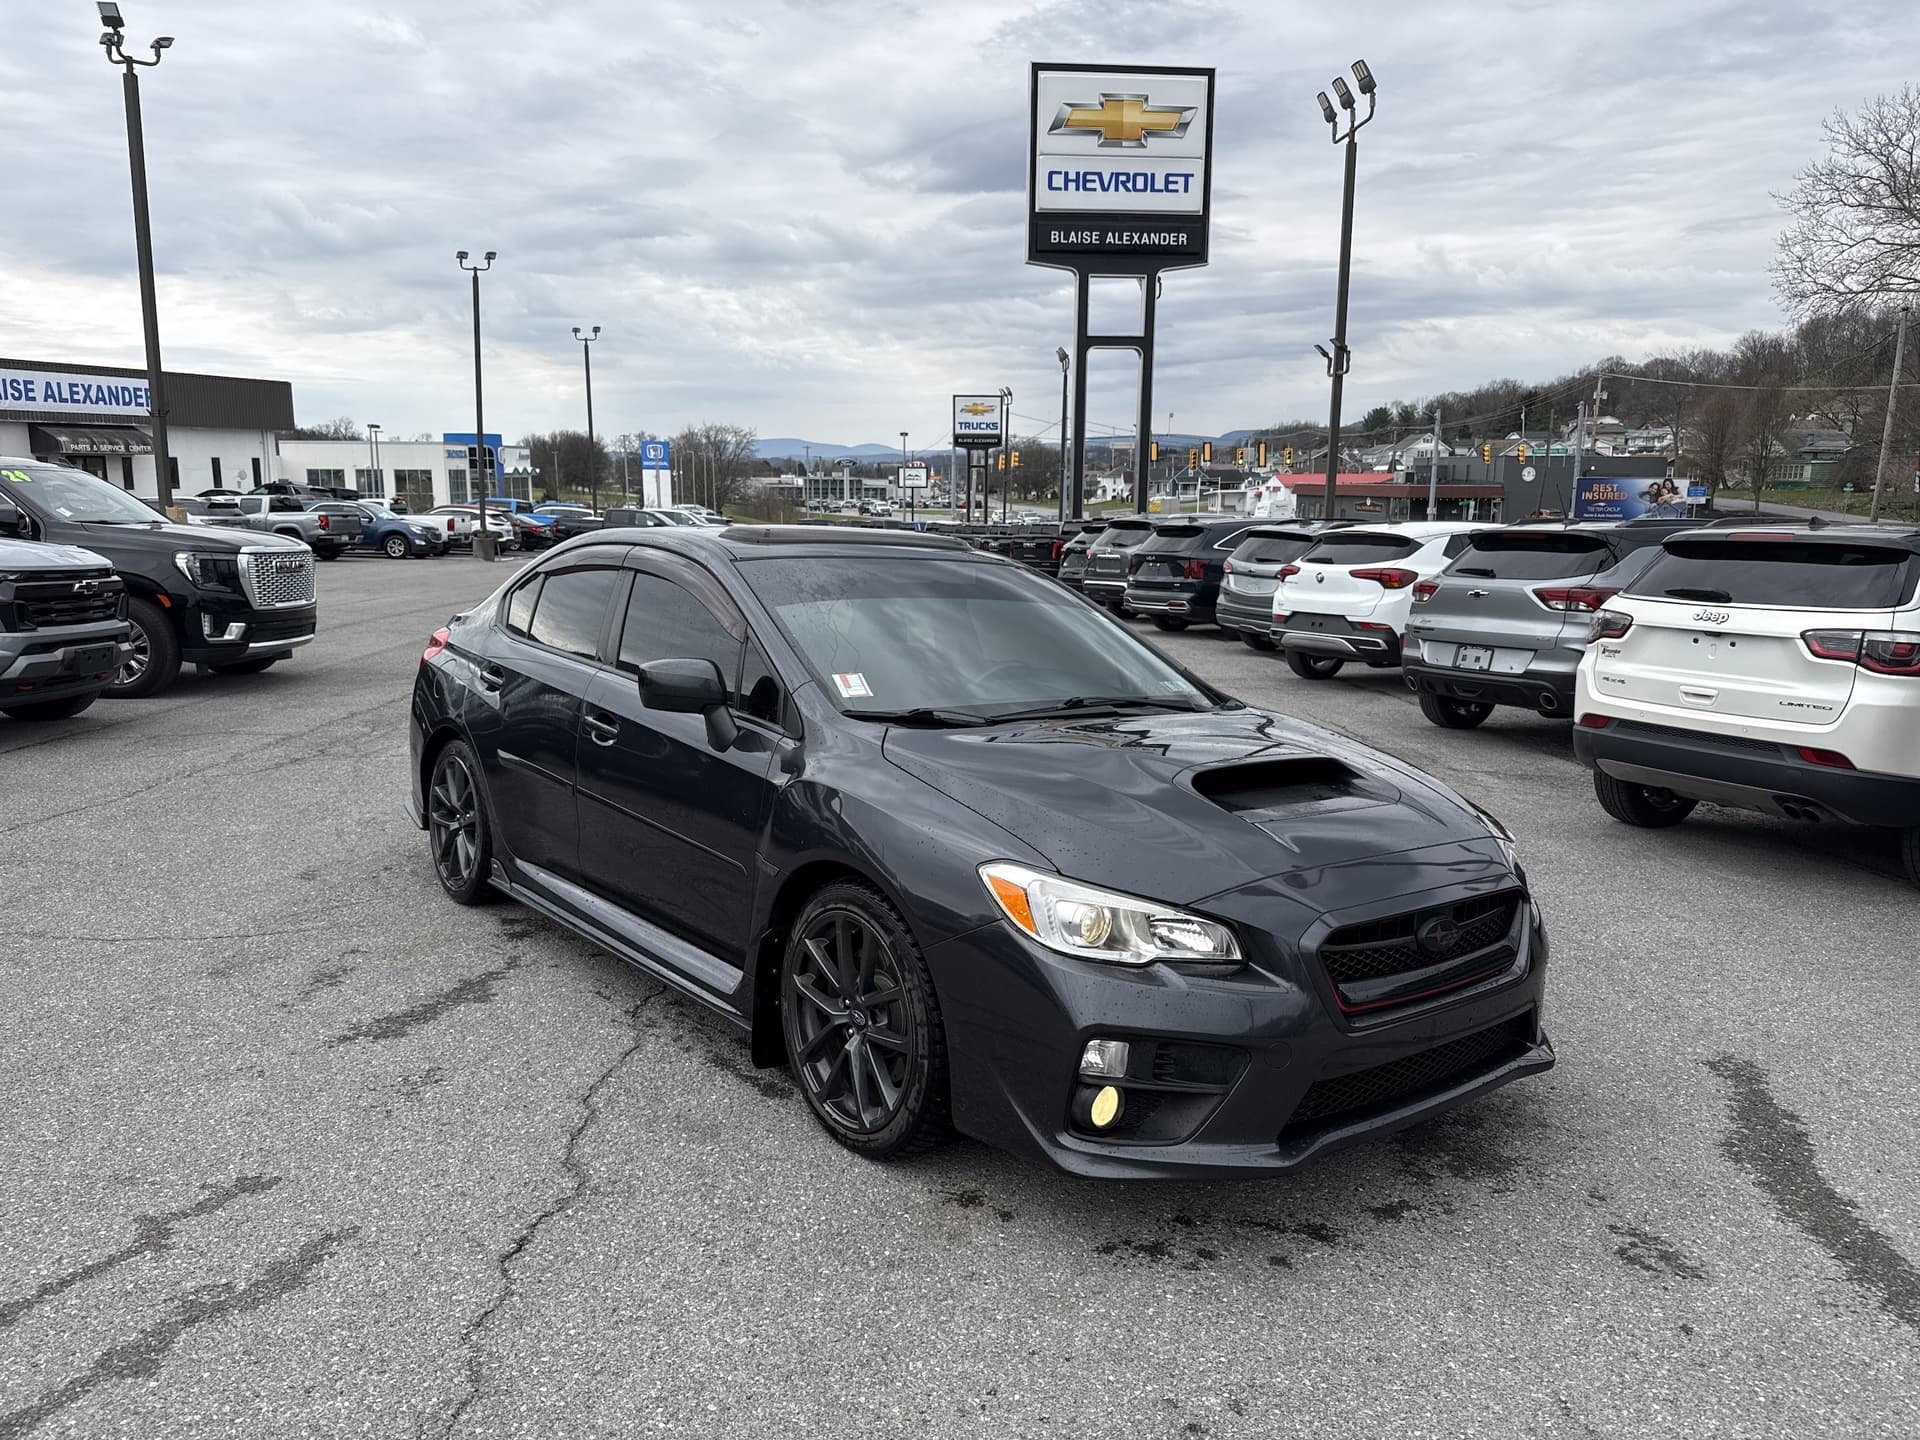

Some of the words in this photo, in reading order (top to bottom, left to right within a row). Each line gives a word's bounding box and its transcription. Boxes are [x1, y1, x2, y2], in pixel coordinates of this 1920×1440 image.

[1047, 170, 1194, 193] CHEVROLET
[1050, 231, 1100, 244] BLAISE
[1105, 232, 1188, 245] ALEXANDER
[958, 422, 998, 430] TRUCKS
[100, 444, 125, 452] SERVICE
[1592, 484, 1618, 492] REST
[1582, 491, 1628, 500] INSURED
[1693, 609, 1730, 625] Jeep
[1779, 700, 1833, 711] LIMITED
